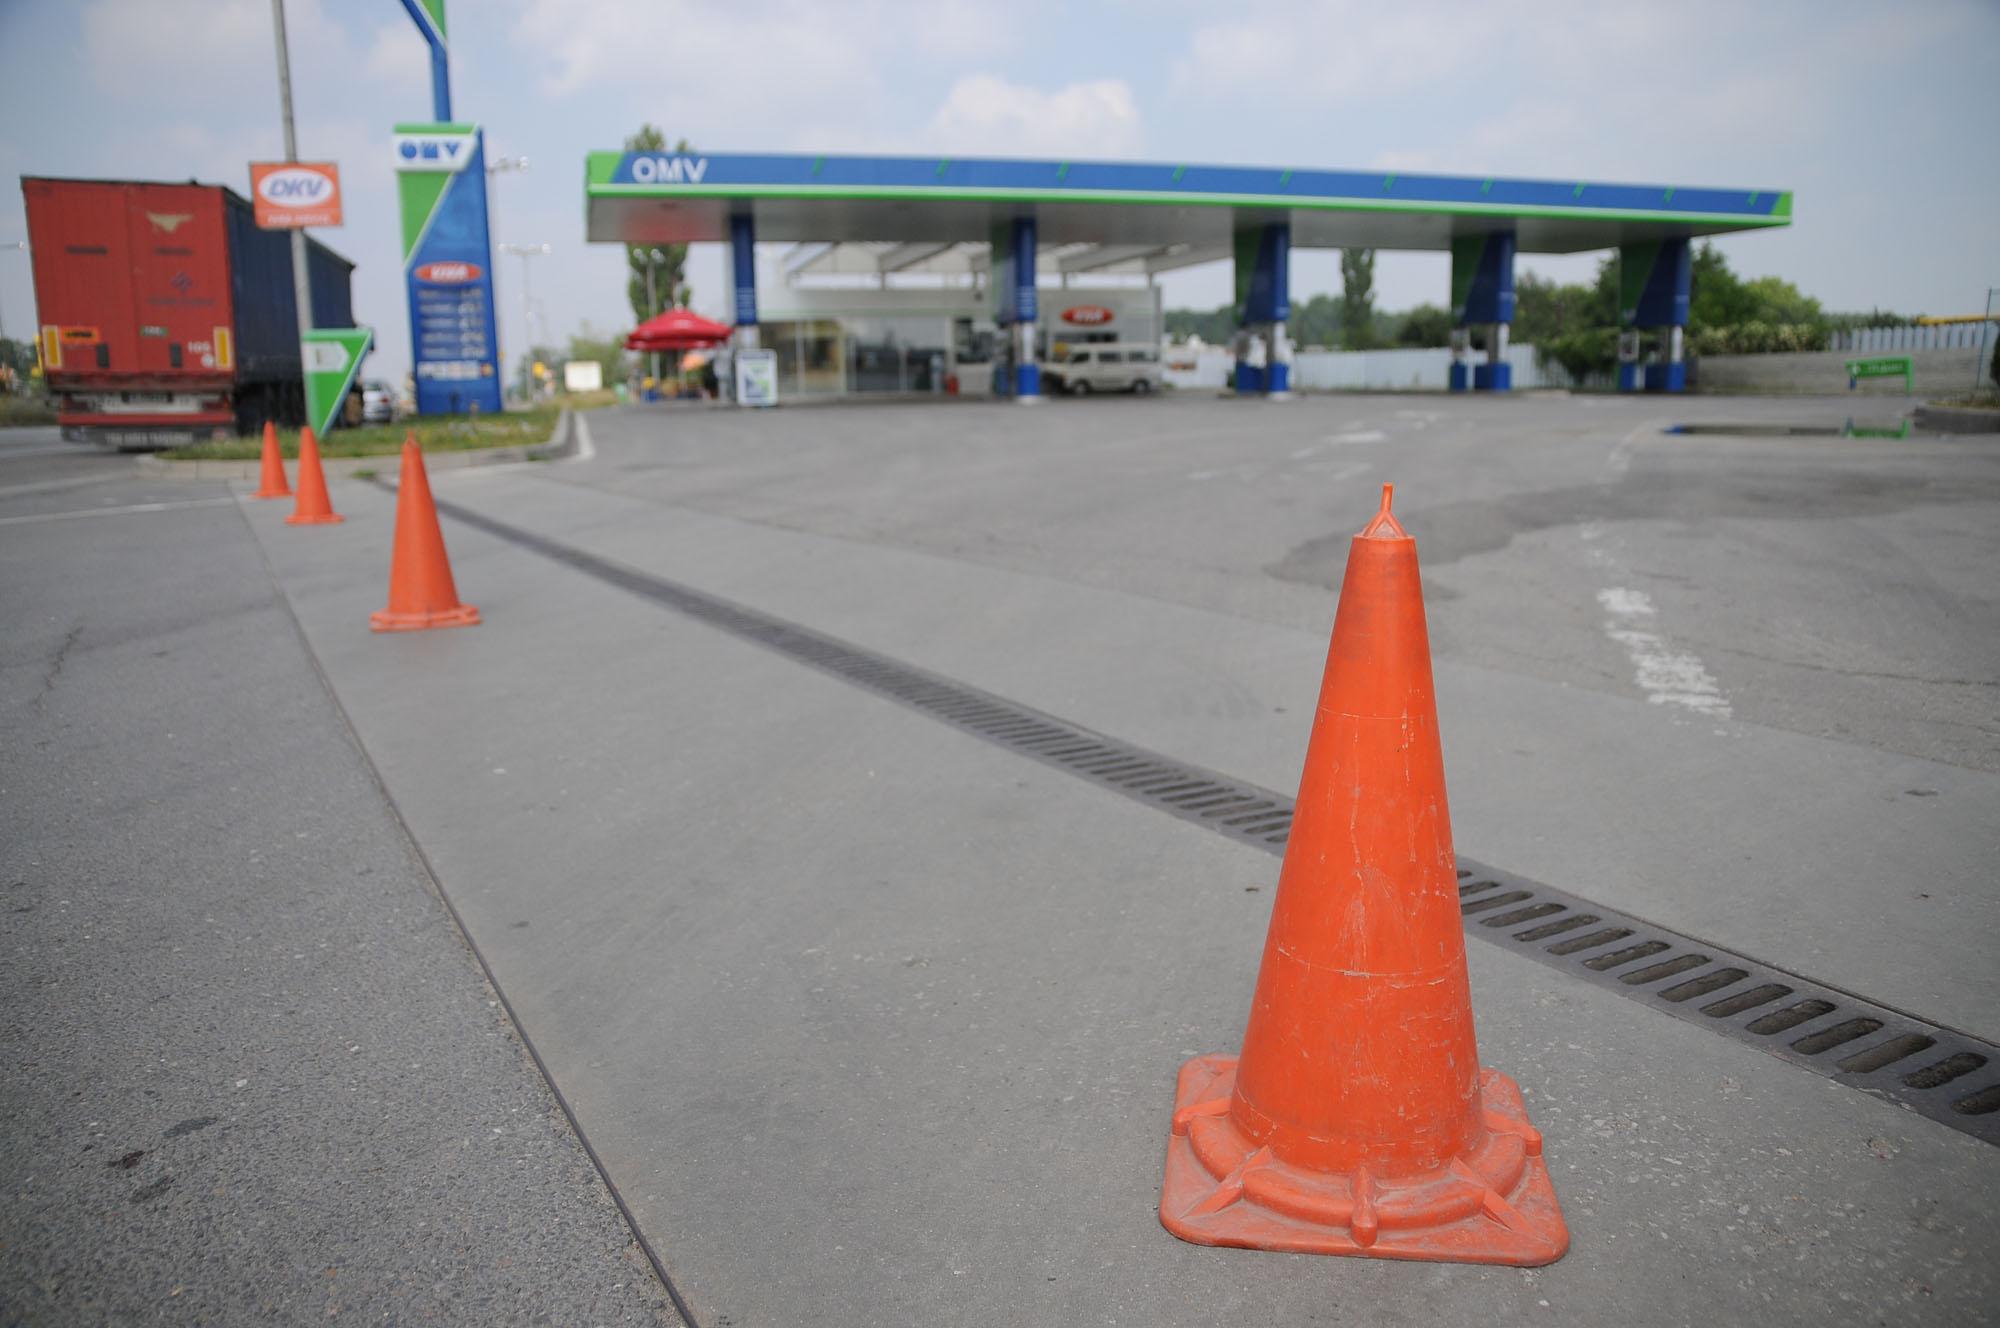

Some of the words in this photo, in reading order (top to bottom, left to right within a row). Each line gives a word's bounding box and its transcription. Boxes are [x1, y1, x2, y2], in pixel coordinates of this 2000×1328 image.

[400, 141, 460, 159] OMV
[632, 156, 708, 183] OMV
[268, 176, 326, 197] DKV
